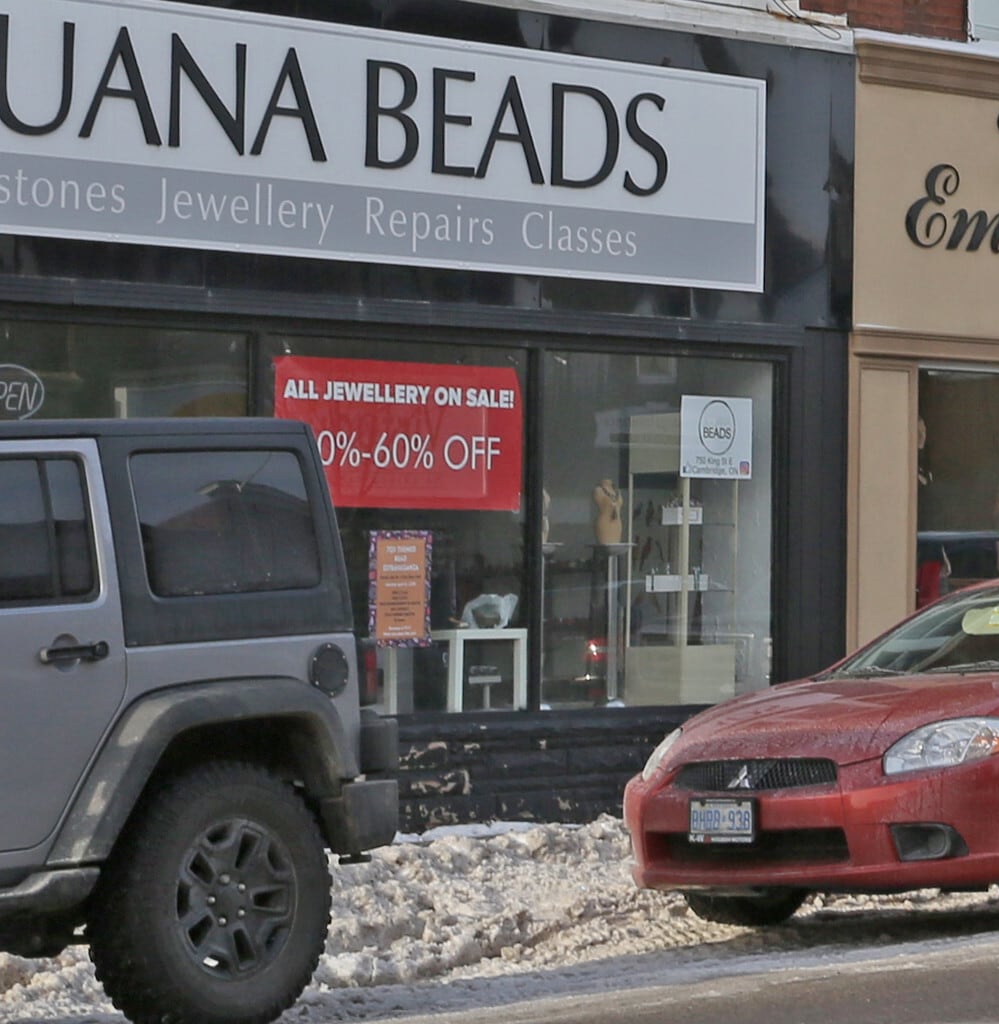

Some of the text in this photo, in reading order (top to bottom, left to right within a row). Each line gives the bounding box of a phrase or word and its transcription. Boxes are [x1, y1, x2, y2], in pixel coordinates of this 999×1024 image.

[364, 59, 669, 197] BEADS
[156, 178, 335, 244] Jewellery
[364, 198, 495, 251] Repairs
[521, 212, 638, 257] Classes
[284, 379, 515, 409] ALL JEWELLERY ON SALE!
[316, 429, 501, 471] 0%-60% OFF
[703, 426, 731, 439] BEADS
